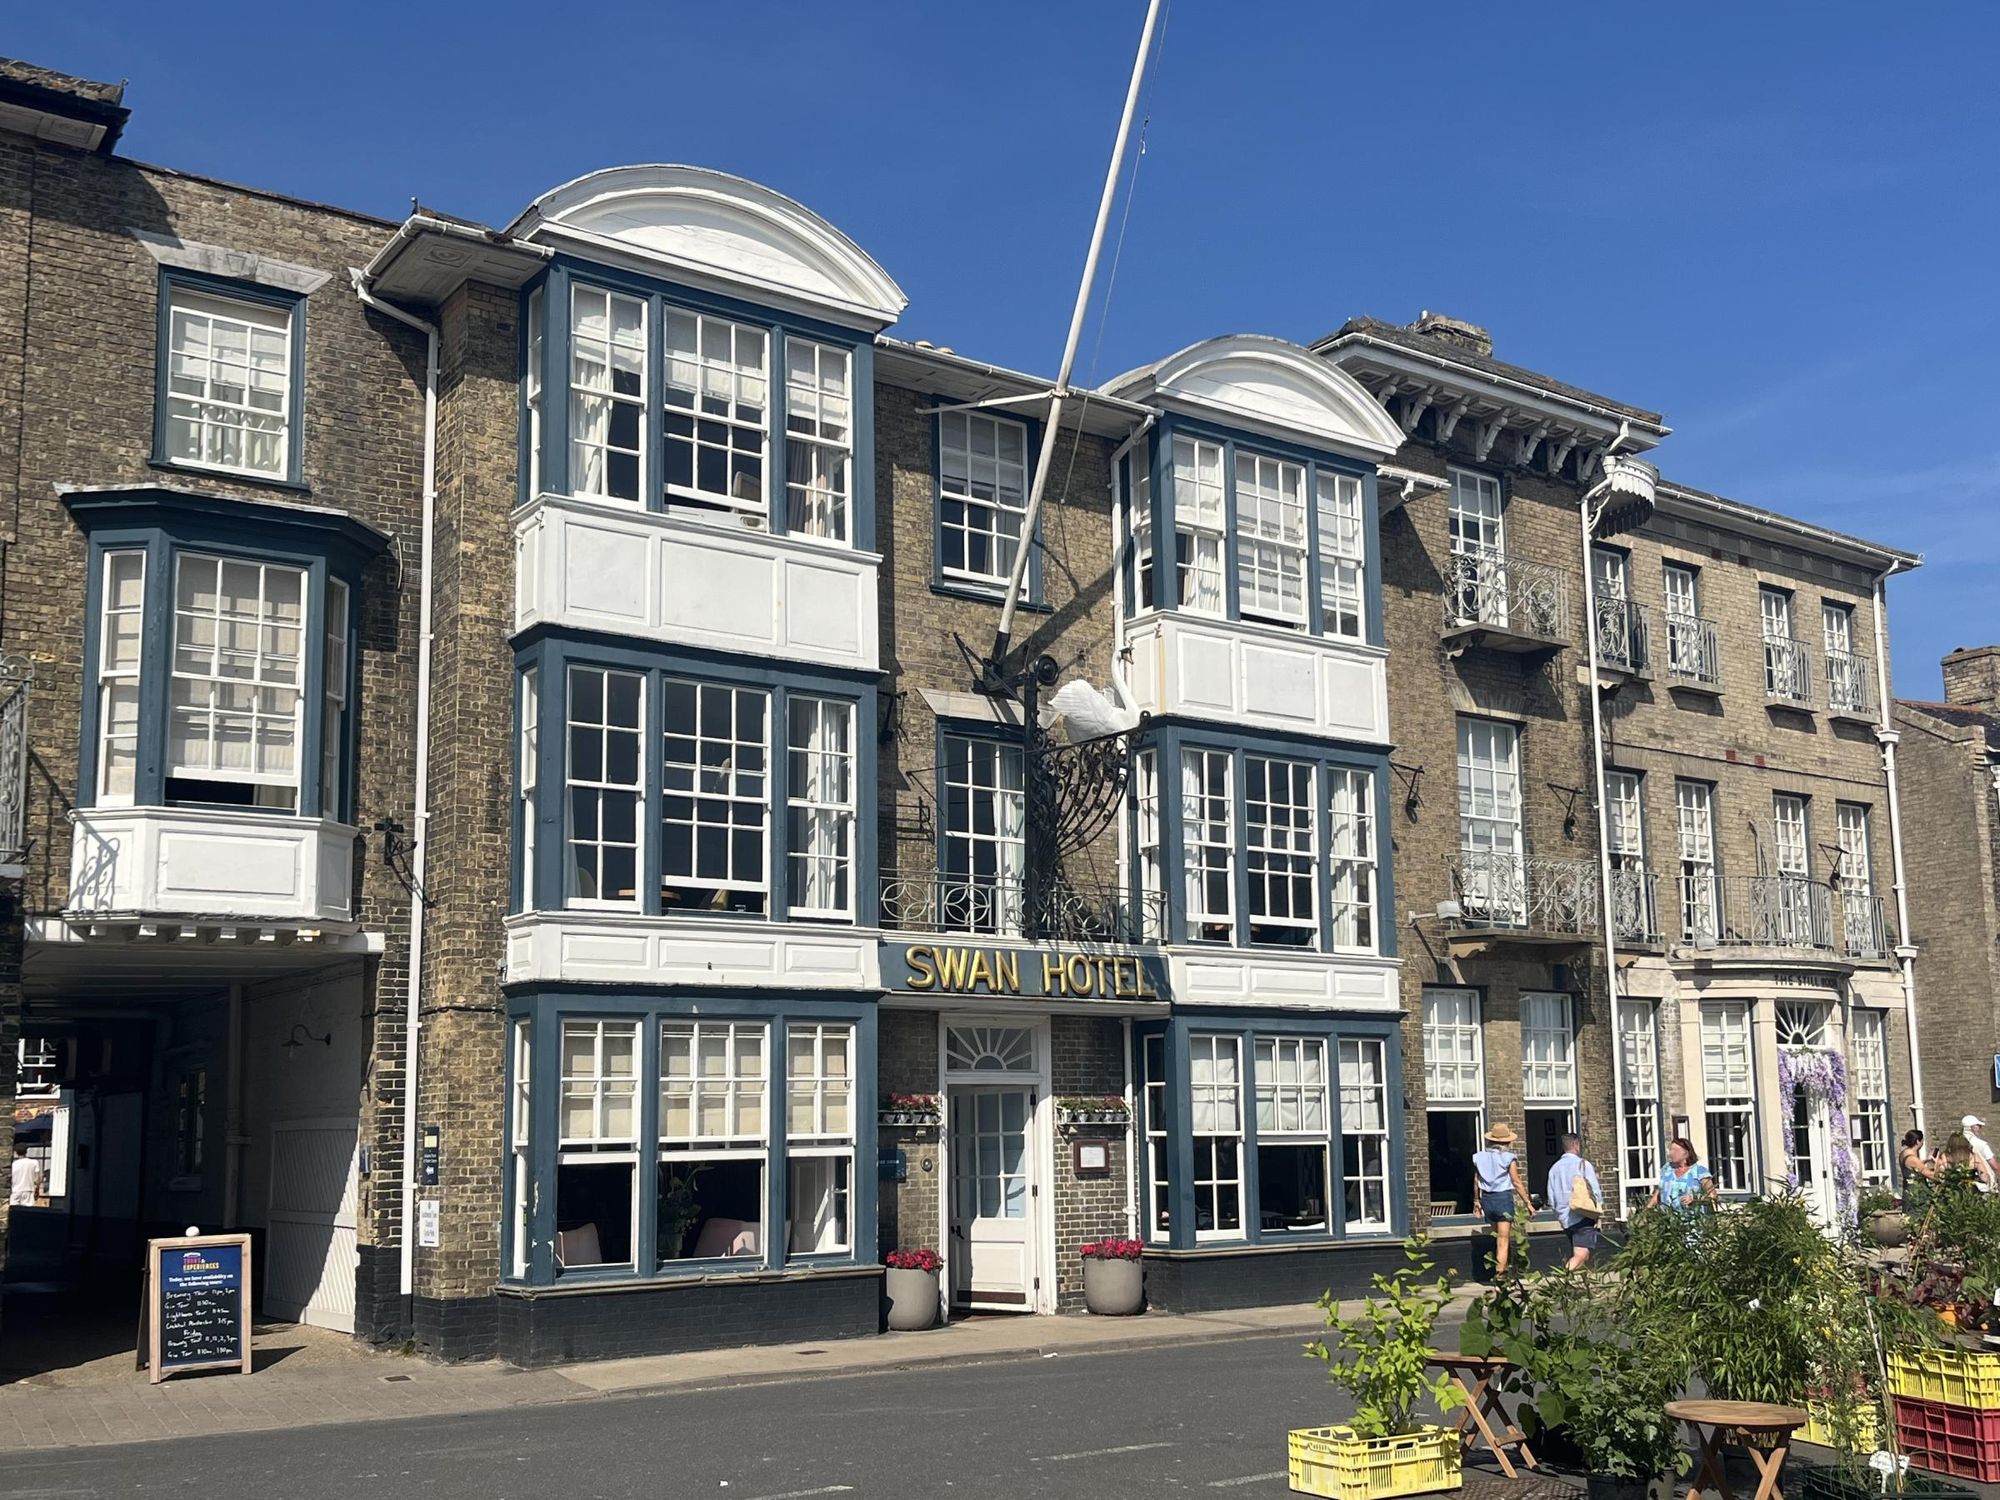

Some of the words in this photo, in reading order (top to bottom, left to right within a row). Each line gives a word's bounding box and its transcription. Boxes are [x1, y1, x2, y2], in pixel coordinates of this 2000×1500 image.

[906, 945, 1020, 993] SWAN
[1042, 952, 1156, 997] HOTEL
[1774, 974, 1793, 986] THE
[1797, 975, 1818, 987] STILL
[183, 1262, 219, 1271] EXPERIENCES
